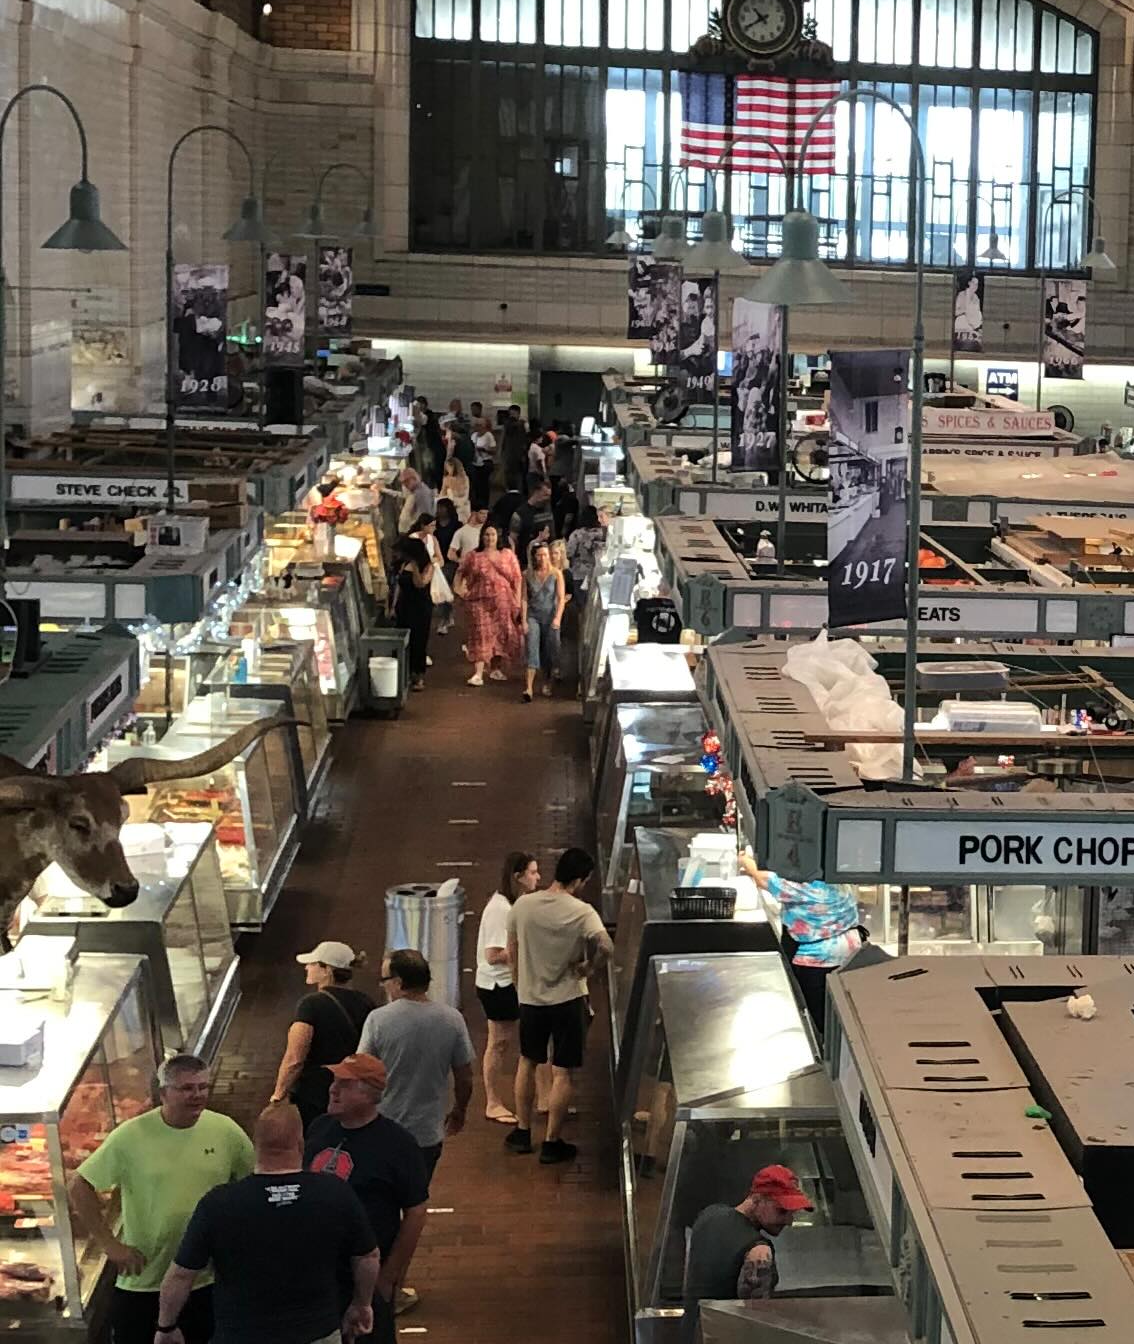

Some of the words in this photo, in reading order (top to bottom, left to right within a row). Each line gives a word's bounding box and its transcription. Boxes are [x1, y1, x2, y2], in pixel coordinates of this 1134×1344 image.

[987, 371, 1018, 385] ATM
[938, 414, 979, 429] SPICES
[987, 418, 995, 429] &
[1003, 416, 1051, 431] SAUCES
[738, 432, 776, 449] 1927
[56, 483, 101, 496] STEVE
[107, 484, 156, 498] CHECK
[840, 558, 896, 589] 1917
[917, 607, 961, 622] EATS
[958, 835, 1044, 865] PORK
